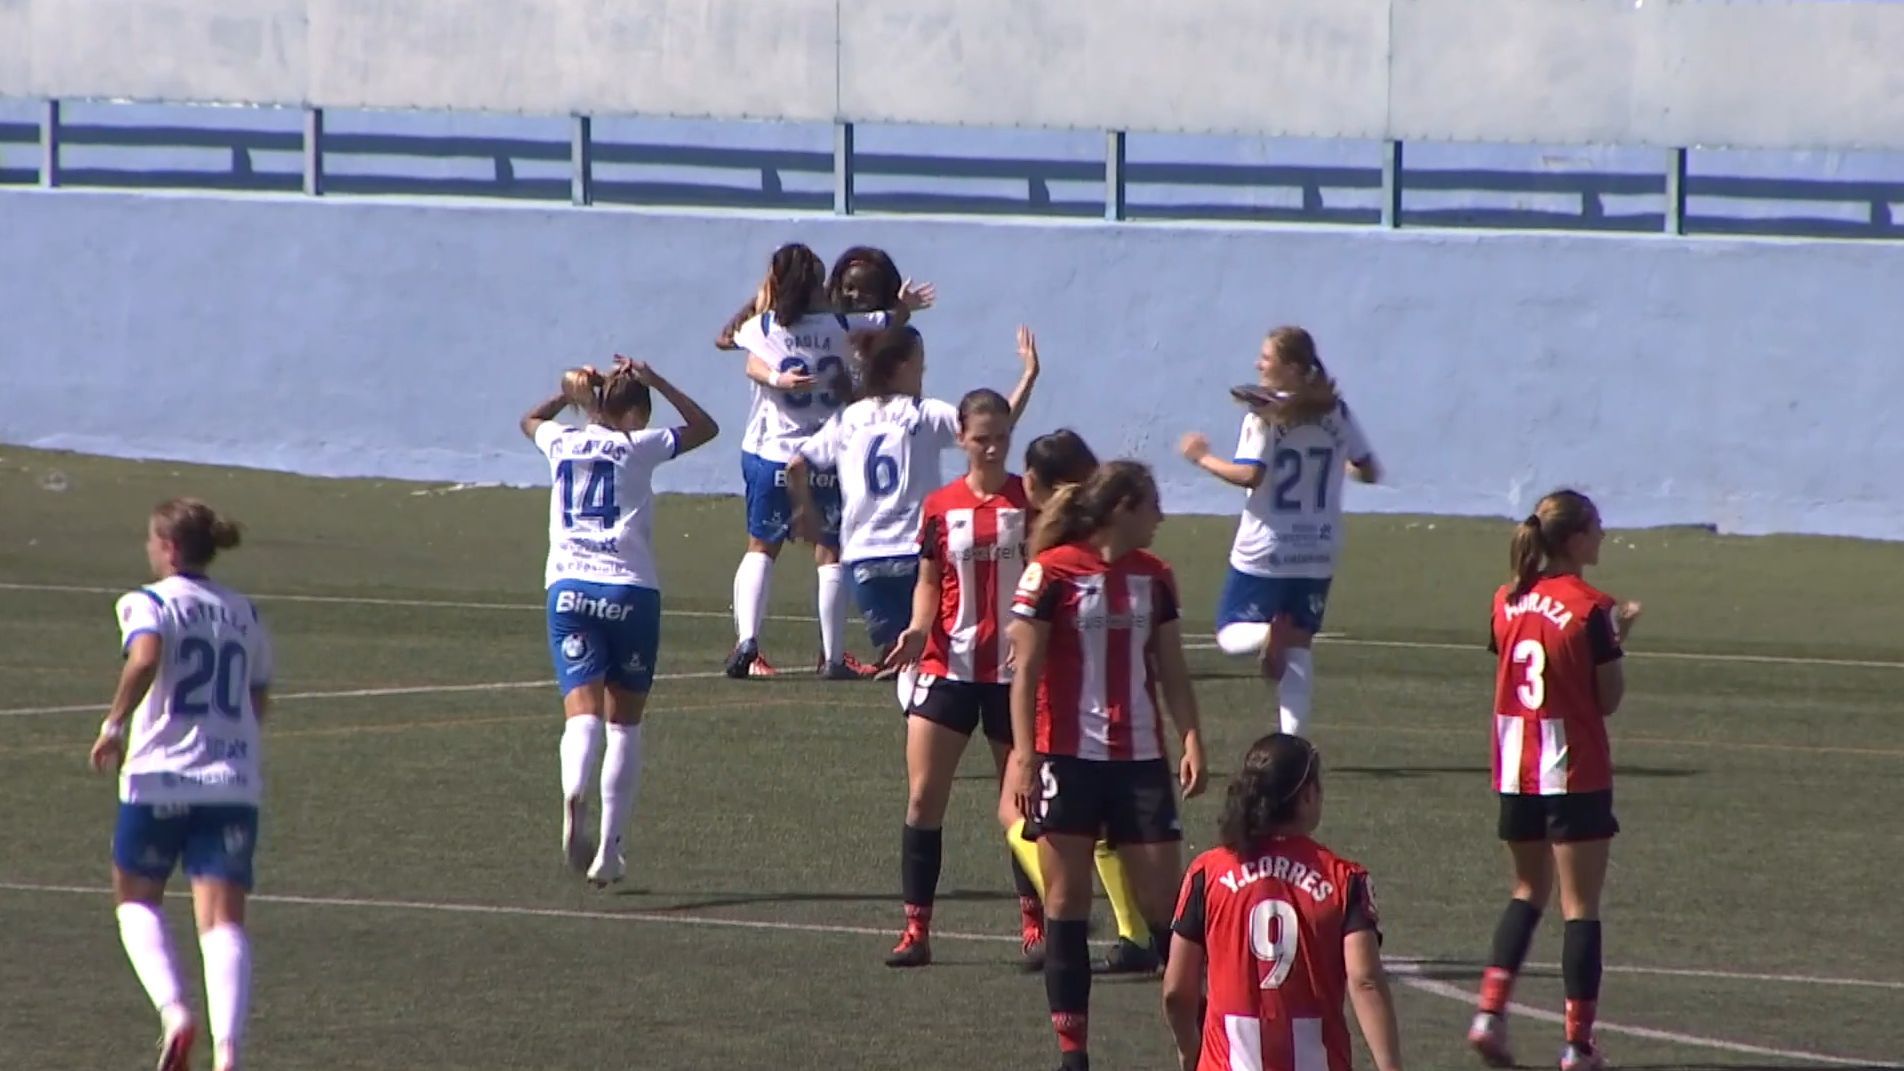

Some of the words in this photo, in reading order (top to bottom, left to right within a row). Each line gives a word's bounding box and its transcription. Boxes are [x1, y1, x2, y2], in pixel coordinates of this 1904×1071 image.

[556, 459, 621, 530] 14
[774, 468, 837, 488] Bter
[864, 432, 900, 497] 6
[1273, 446, 1334, 513] 27
[555, 590, 634, 622] Binter
[171, 636, 248, 719] 20
[1512, 638, 1546, 711] 3
[1218, 855, 1334, 902] Y.CORRES
[1249, 898, 1299, 990] 9
